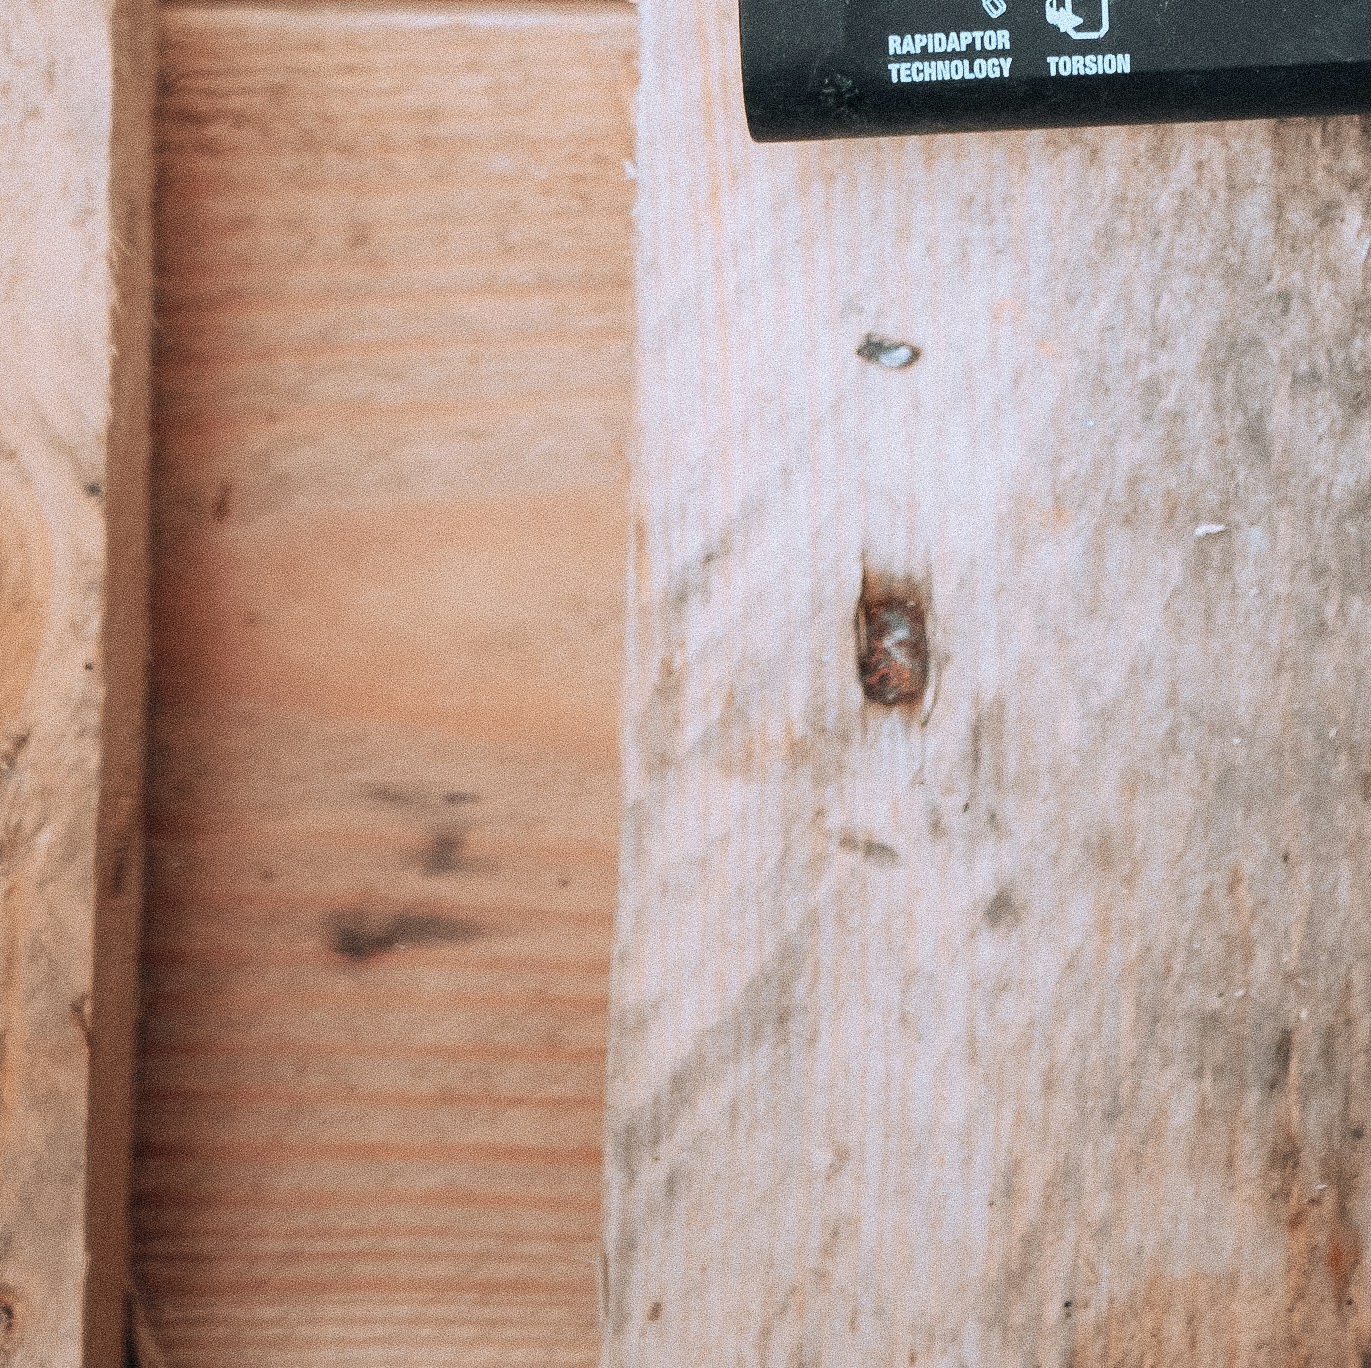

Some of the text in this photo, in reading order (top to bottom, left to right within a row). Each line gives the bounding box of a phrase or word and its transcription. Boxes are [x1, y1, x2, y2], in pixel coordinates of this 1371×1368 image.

[887, 29, 1011, 56] RAPIDAPTOR
[887, 57, 1013, 84] TECHNOLOGY
[1046, 53, 1131, 77] TORSION
